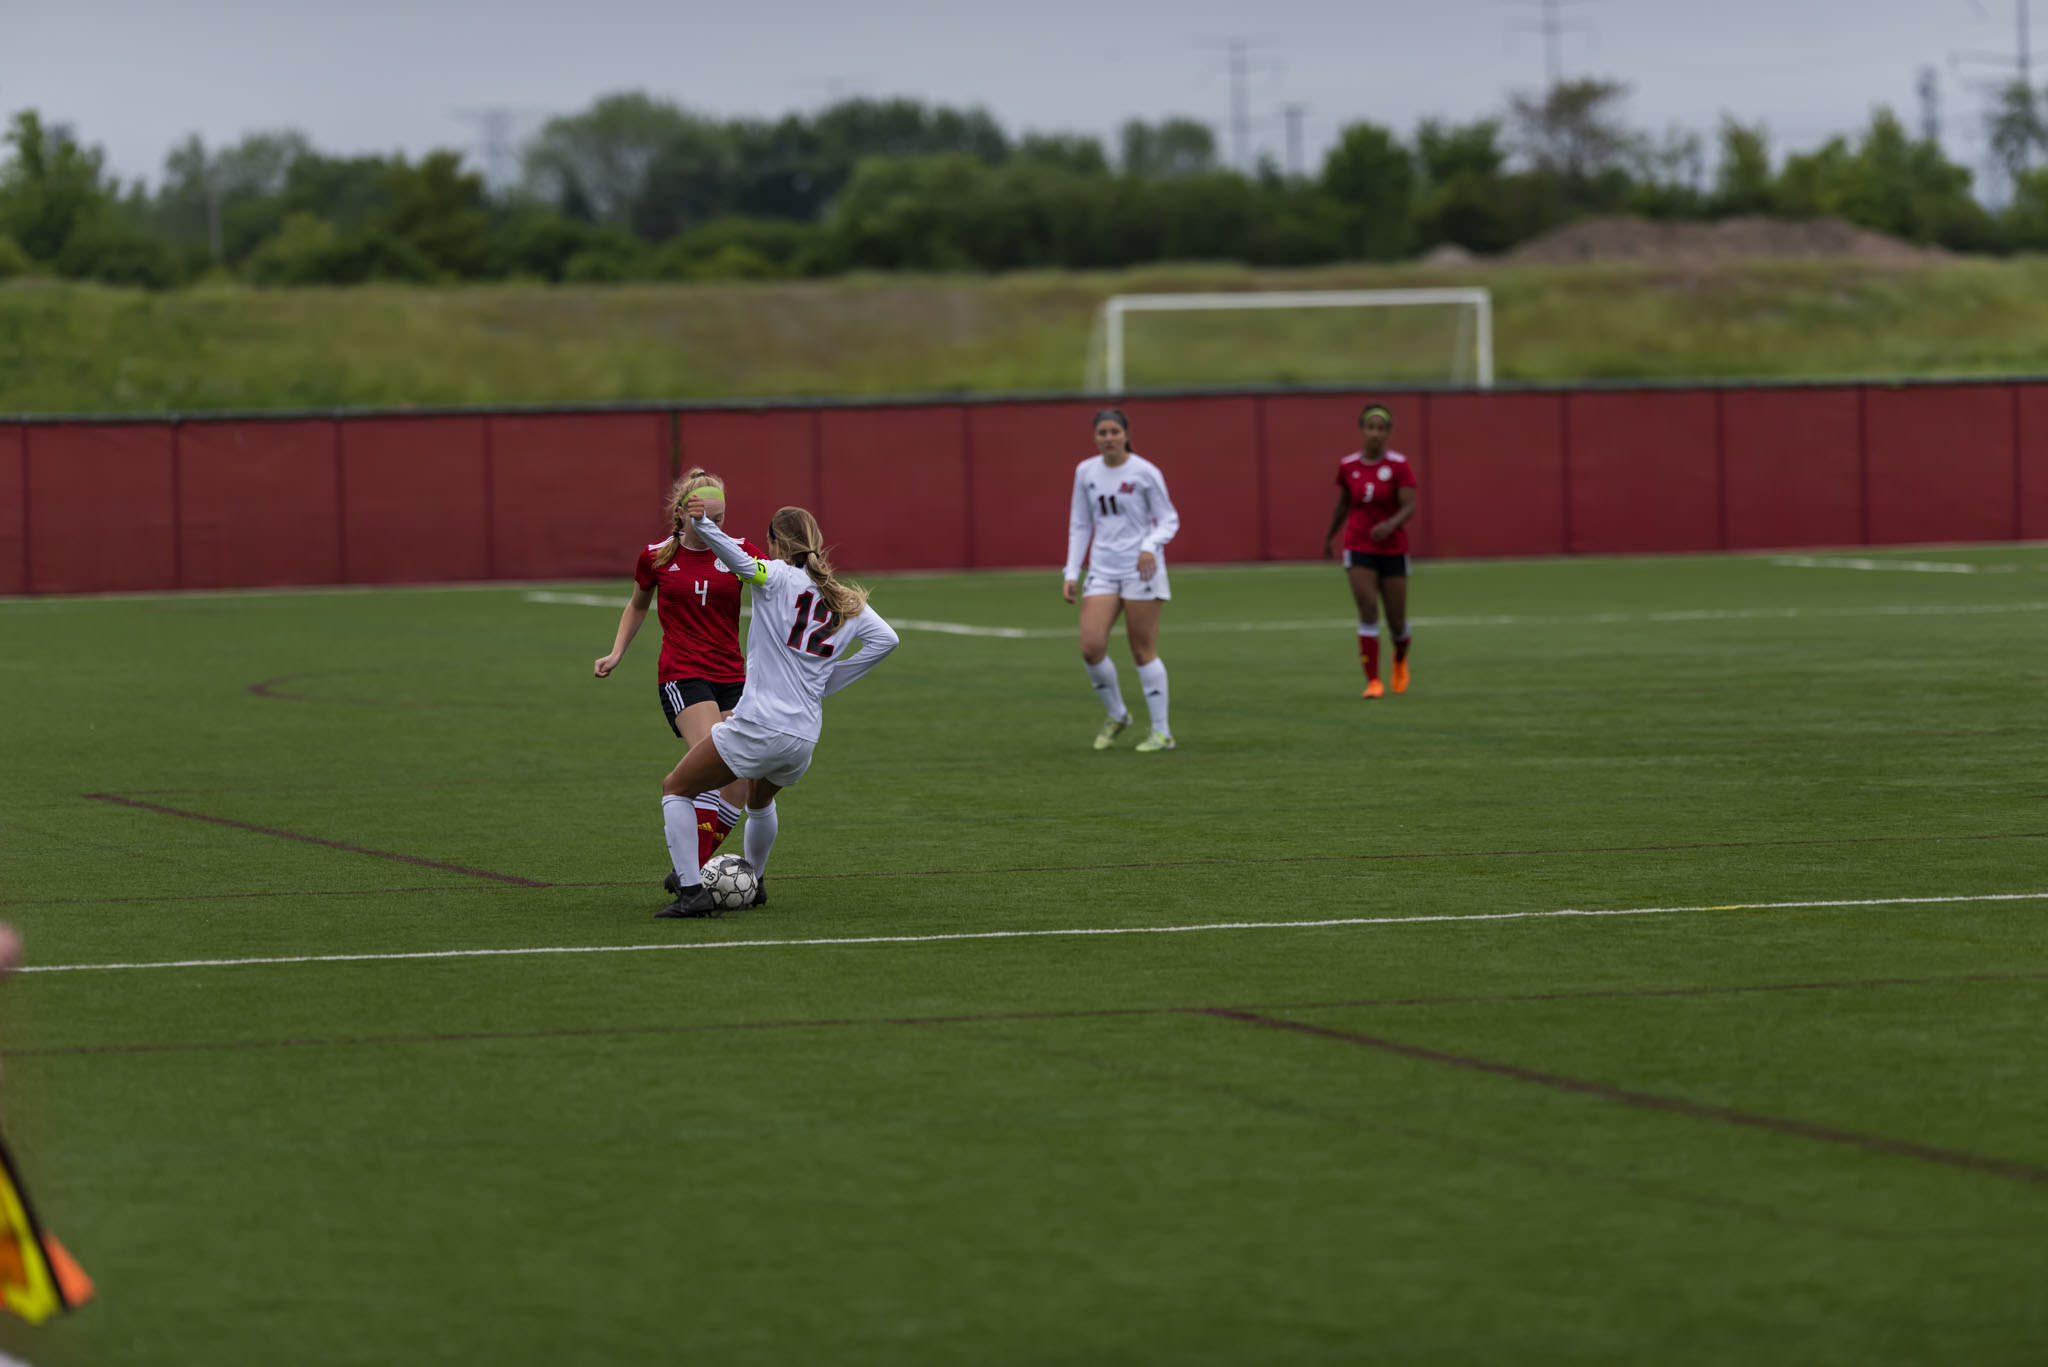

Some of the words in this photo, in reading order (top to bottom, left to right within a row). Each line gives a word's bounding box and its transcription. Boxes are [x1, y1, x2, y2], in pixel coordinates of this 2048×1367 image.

[1098, 494, 1119, 516] 11
[694, 579, 708, 606] 4
[787, 589, 835, 658] 12
